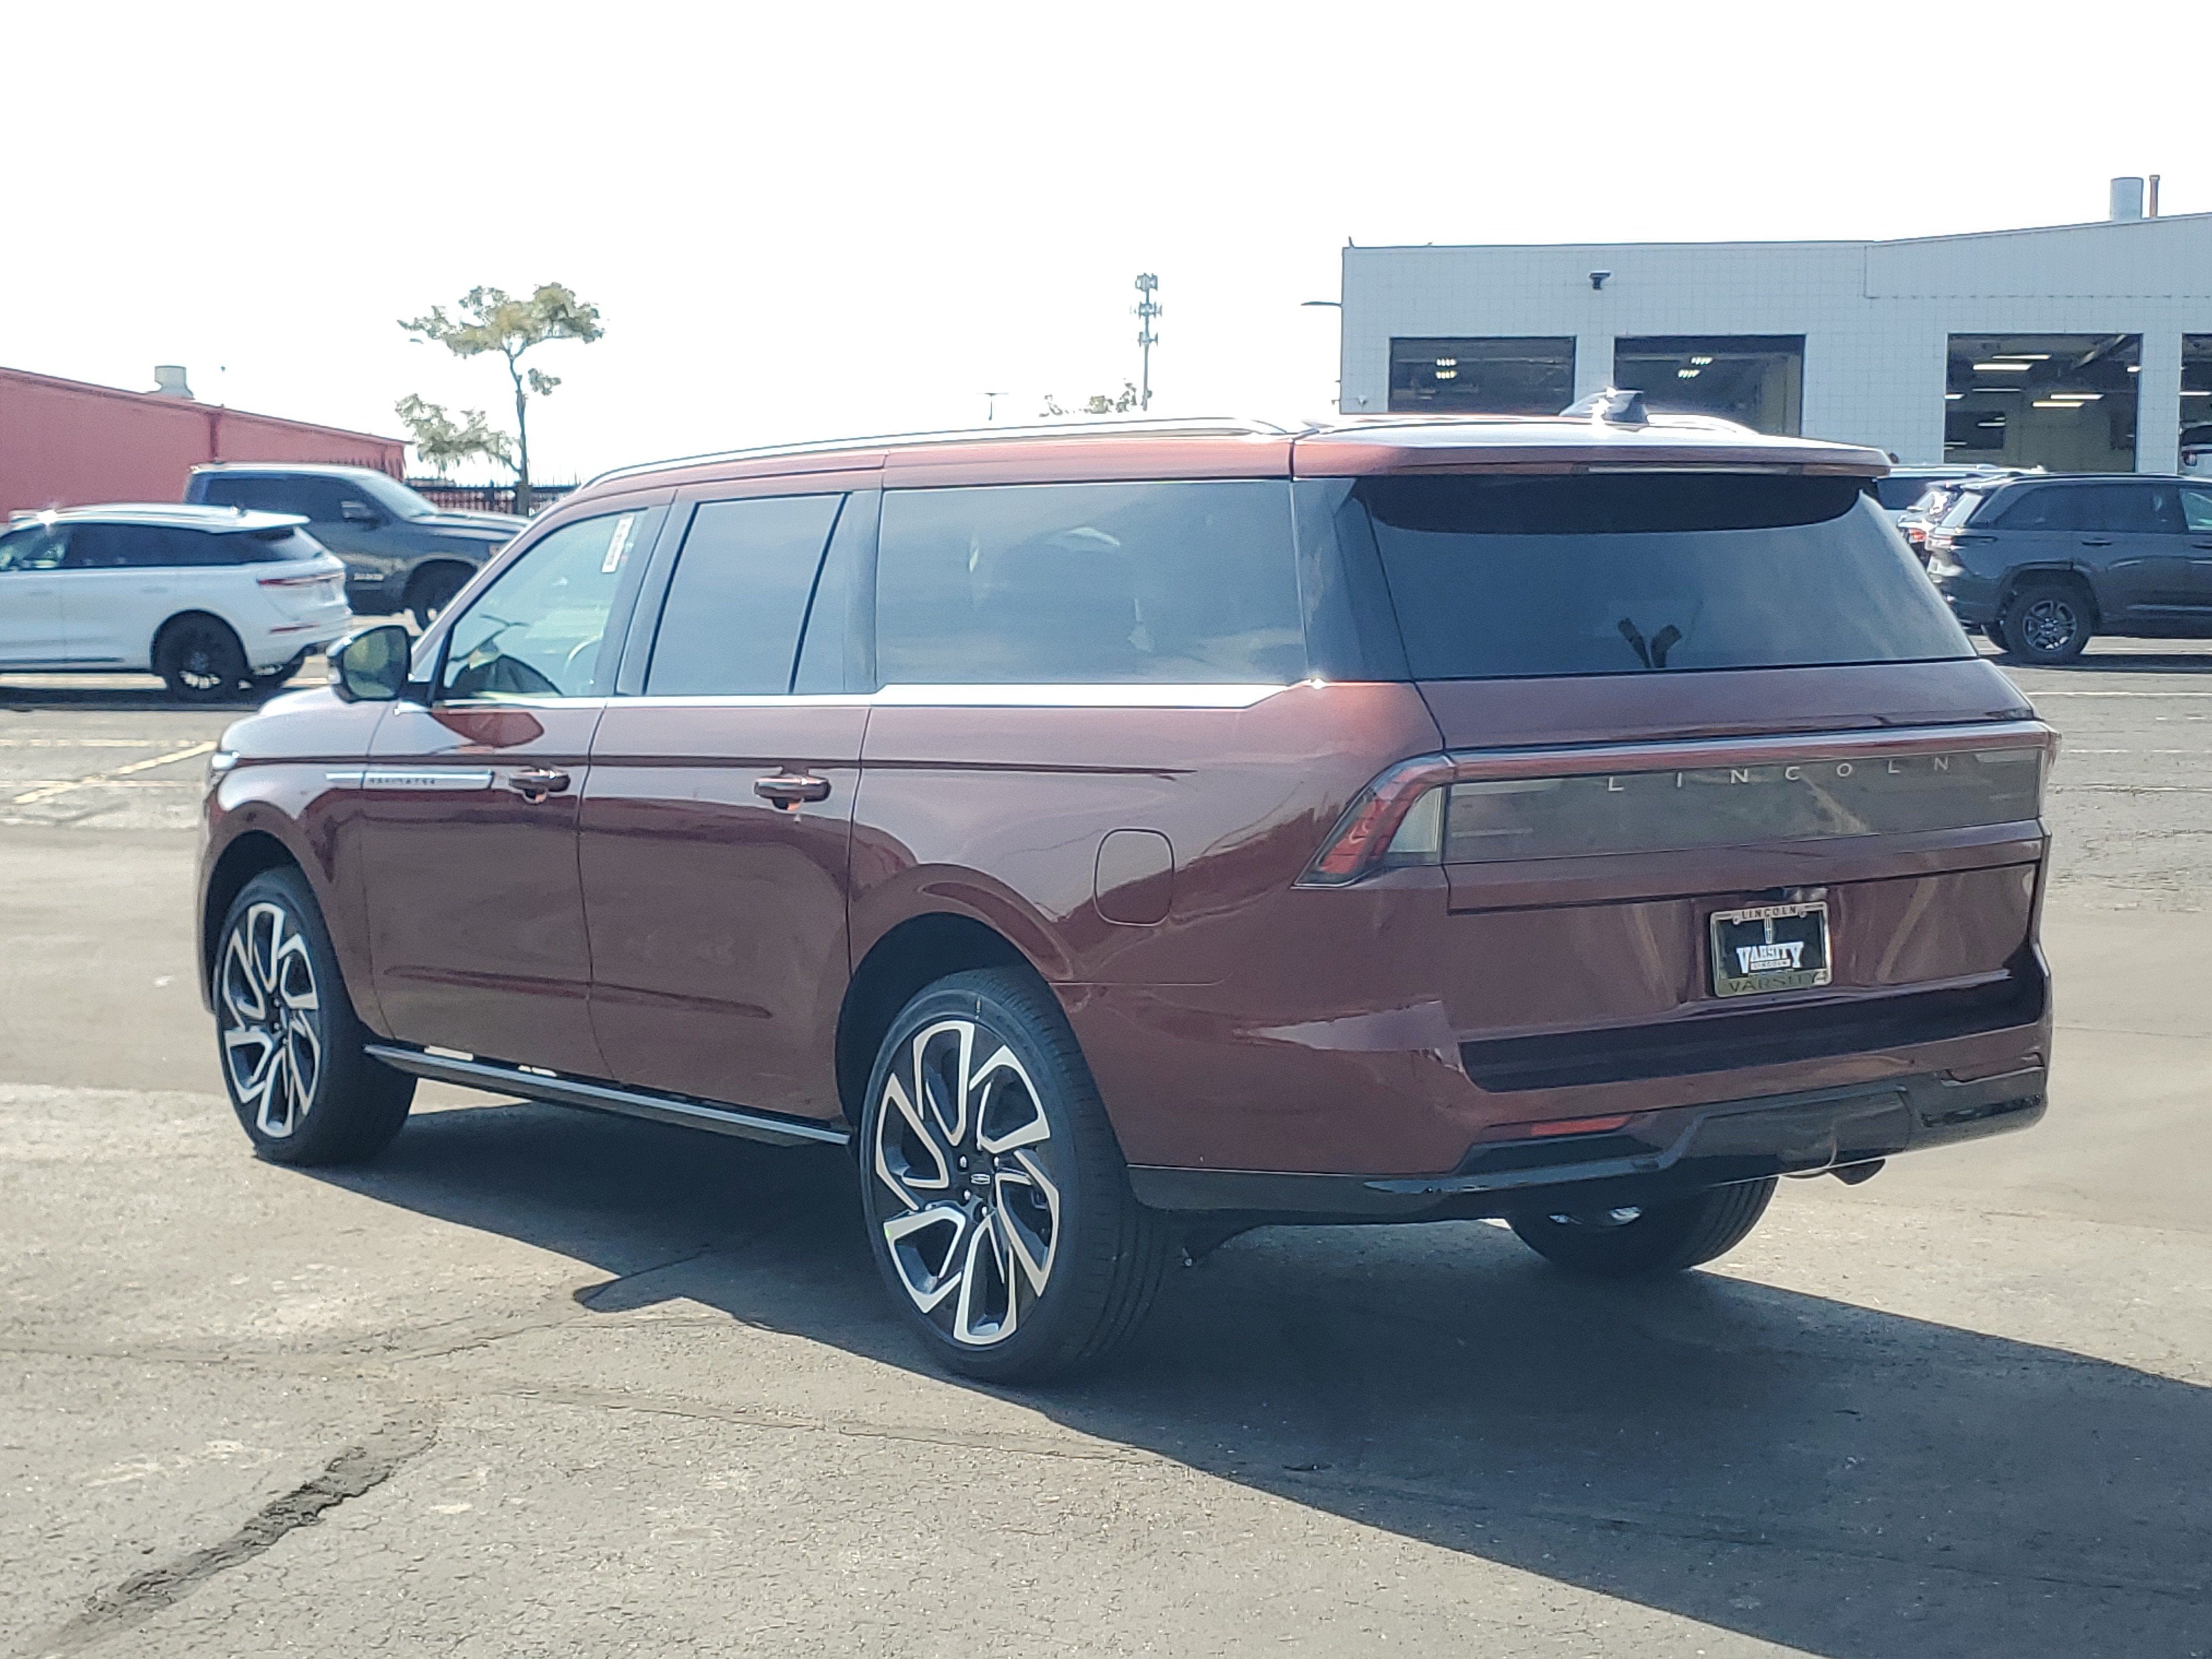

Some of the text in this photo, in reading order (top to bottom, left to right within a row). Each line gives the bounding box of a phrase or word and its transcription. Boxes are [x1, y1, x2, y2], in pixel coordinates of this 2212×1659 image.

[1607, 757, 1949, 792] LINCOLN
[1741, 906, 1796, 919] LINCOLN
[1736, 941, 1804, 974] VARSITY
